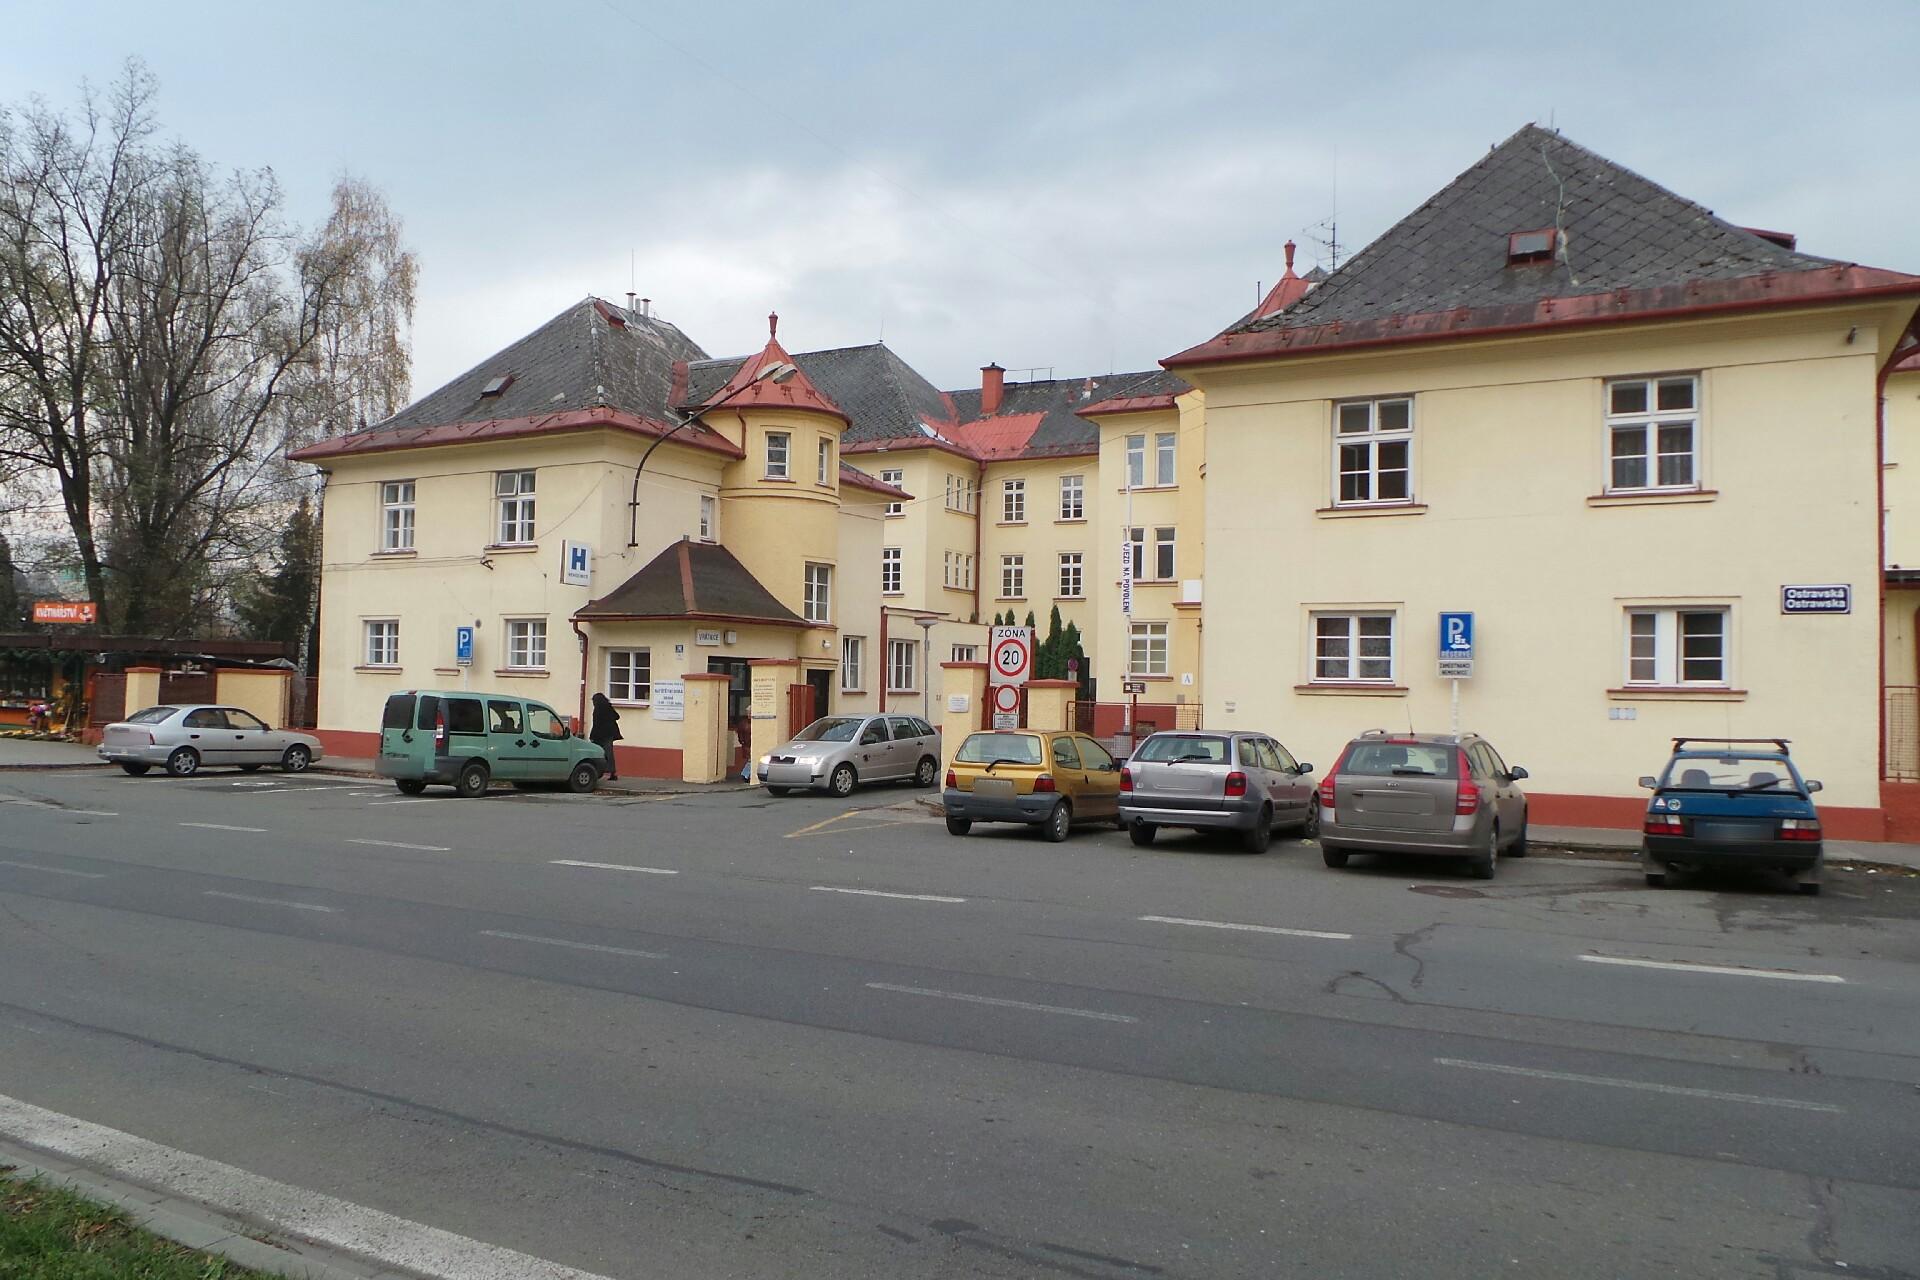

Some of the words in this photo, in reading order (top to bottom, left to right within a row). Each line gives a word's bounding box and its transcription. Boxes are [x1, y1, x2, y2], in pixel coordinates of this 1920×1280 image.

[571, 548, 587, 571] H
[1123, 568, 1130, 577] NA
[998, 627, 1025, 638] ZÓNA
[1448, 618, 1464, 643] P
[460, 631, 469, 648] P
[1003, 650, 1019, 665] 20
